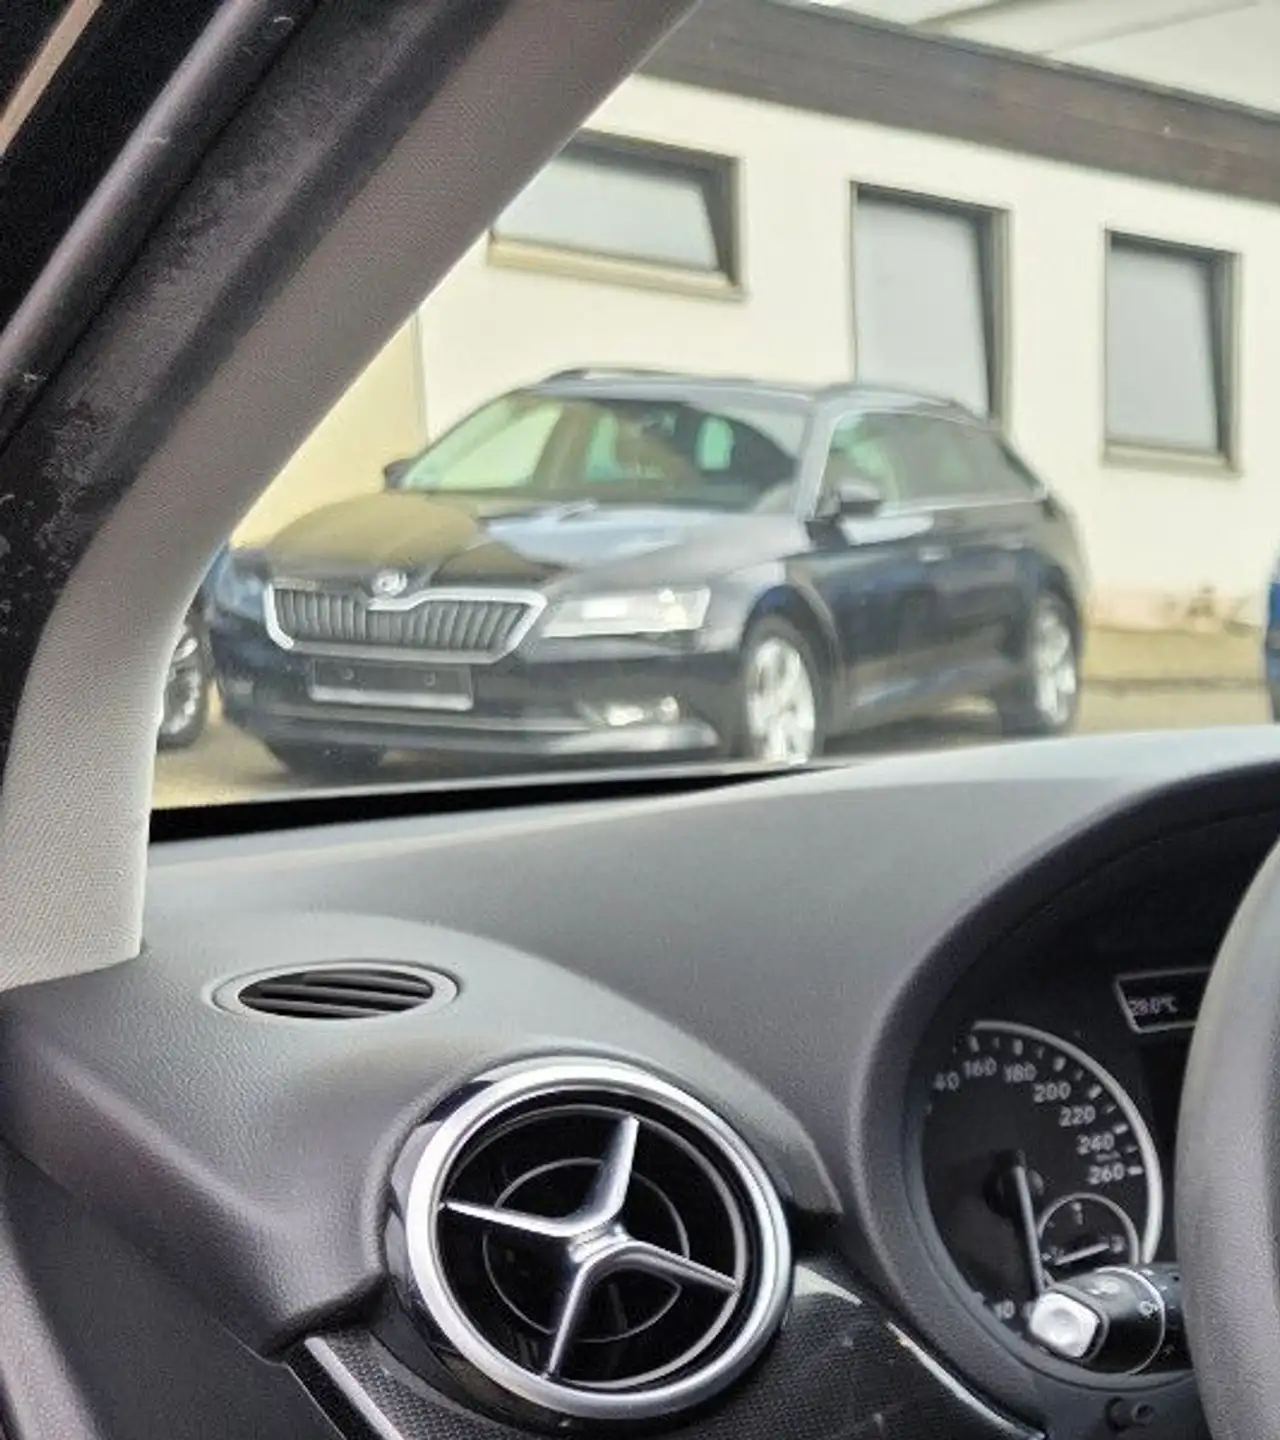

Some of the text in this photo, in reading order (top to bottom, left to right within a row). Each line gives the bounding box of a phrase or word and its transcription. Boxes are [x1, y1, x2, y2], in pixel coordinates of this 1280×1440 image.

[962, 1057, 998, 1080] 160
[1003, 1062, 1037, 1083] 180
[933, 1071, 960, 1091] 40
[1033, 1081, 1072, 1103] 200
[1058, 1104, 1096, 1127] 220
[1076, 1132, 1115, 1155] 240
[1087, 1161, 1125, 1184] 260
